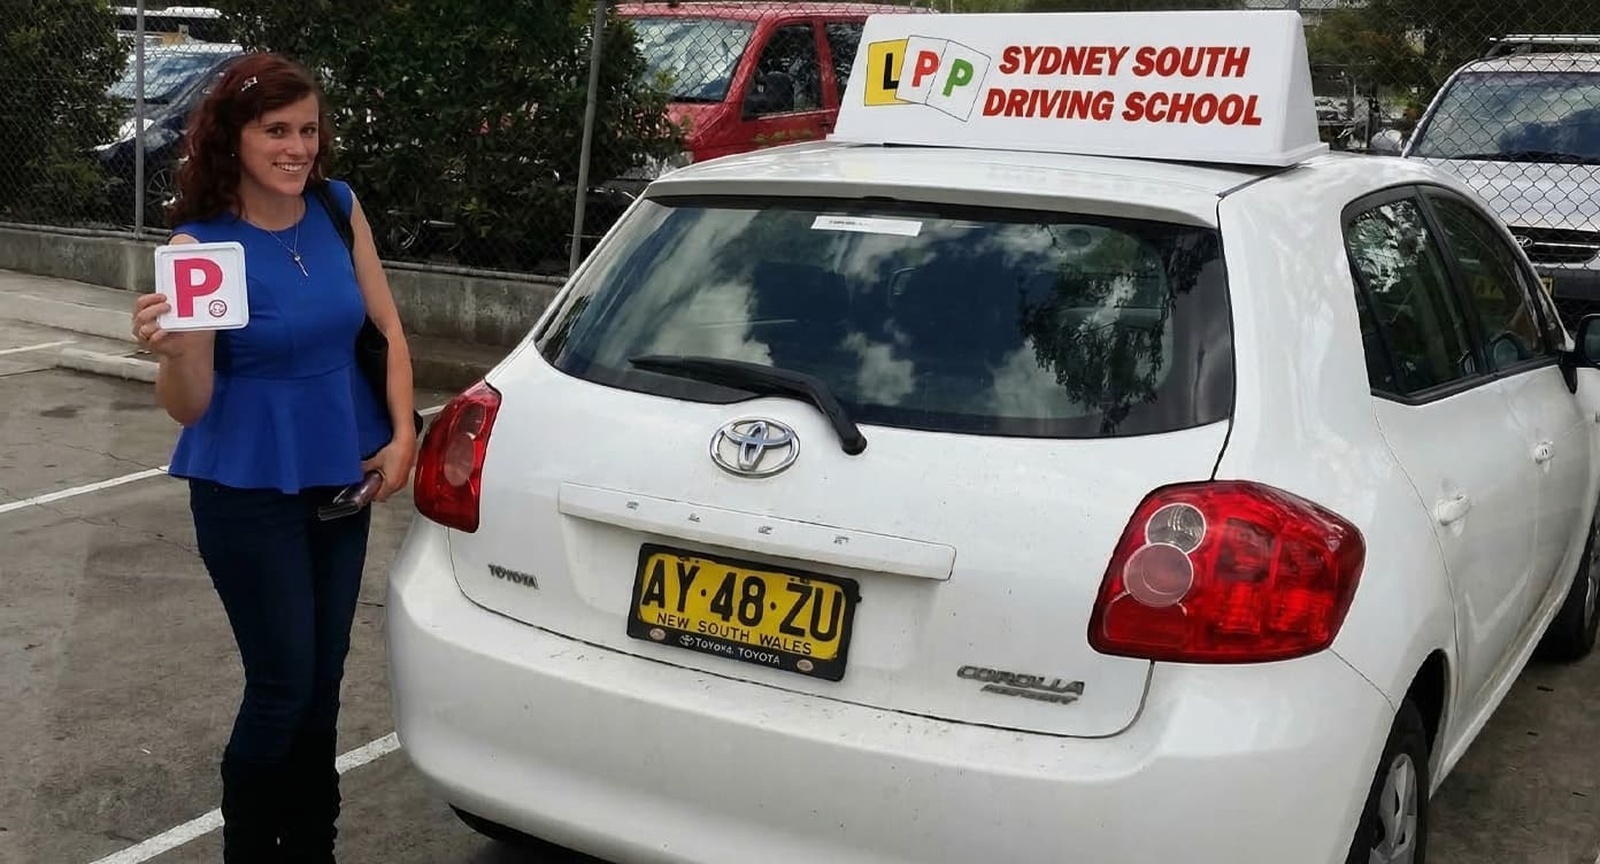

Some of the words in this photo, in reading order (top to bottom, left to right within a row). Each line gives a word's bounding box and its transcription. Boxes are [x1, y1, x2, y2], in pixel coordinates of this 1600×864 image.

[883, 52, 900, 90] L
[911, 50, 940, 88] P
[942, 58, 974, 97] P
[999, 46, 1130, 76] SYDNEY
[1132, 46, 1251, 77] SOUTH
[982, 88, 1115, 121] DRIVING
[1122, 91, 1262, 126] SCHOOL
[174, 258, 224, 318] P
[656, 612, 690, 630] NEW
[698, 620, 750, 642] SOUTH
[759, 633, 812, 656] WALES
[738, 647, 781, 666] TOYOTA
